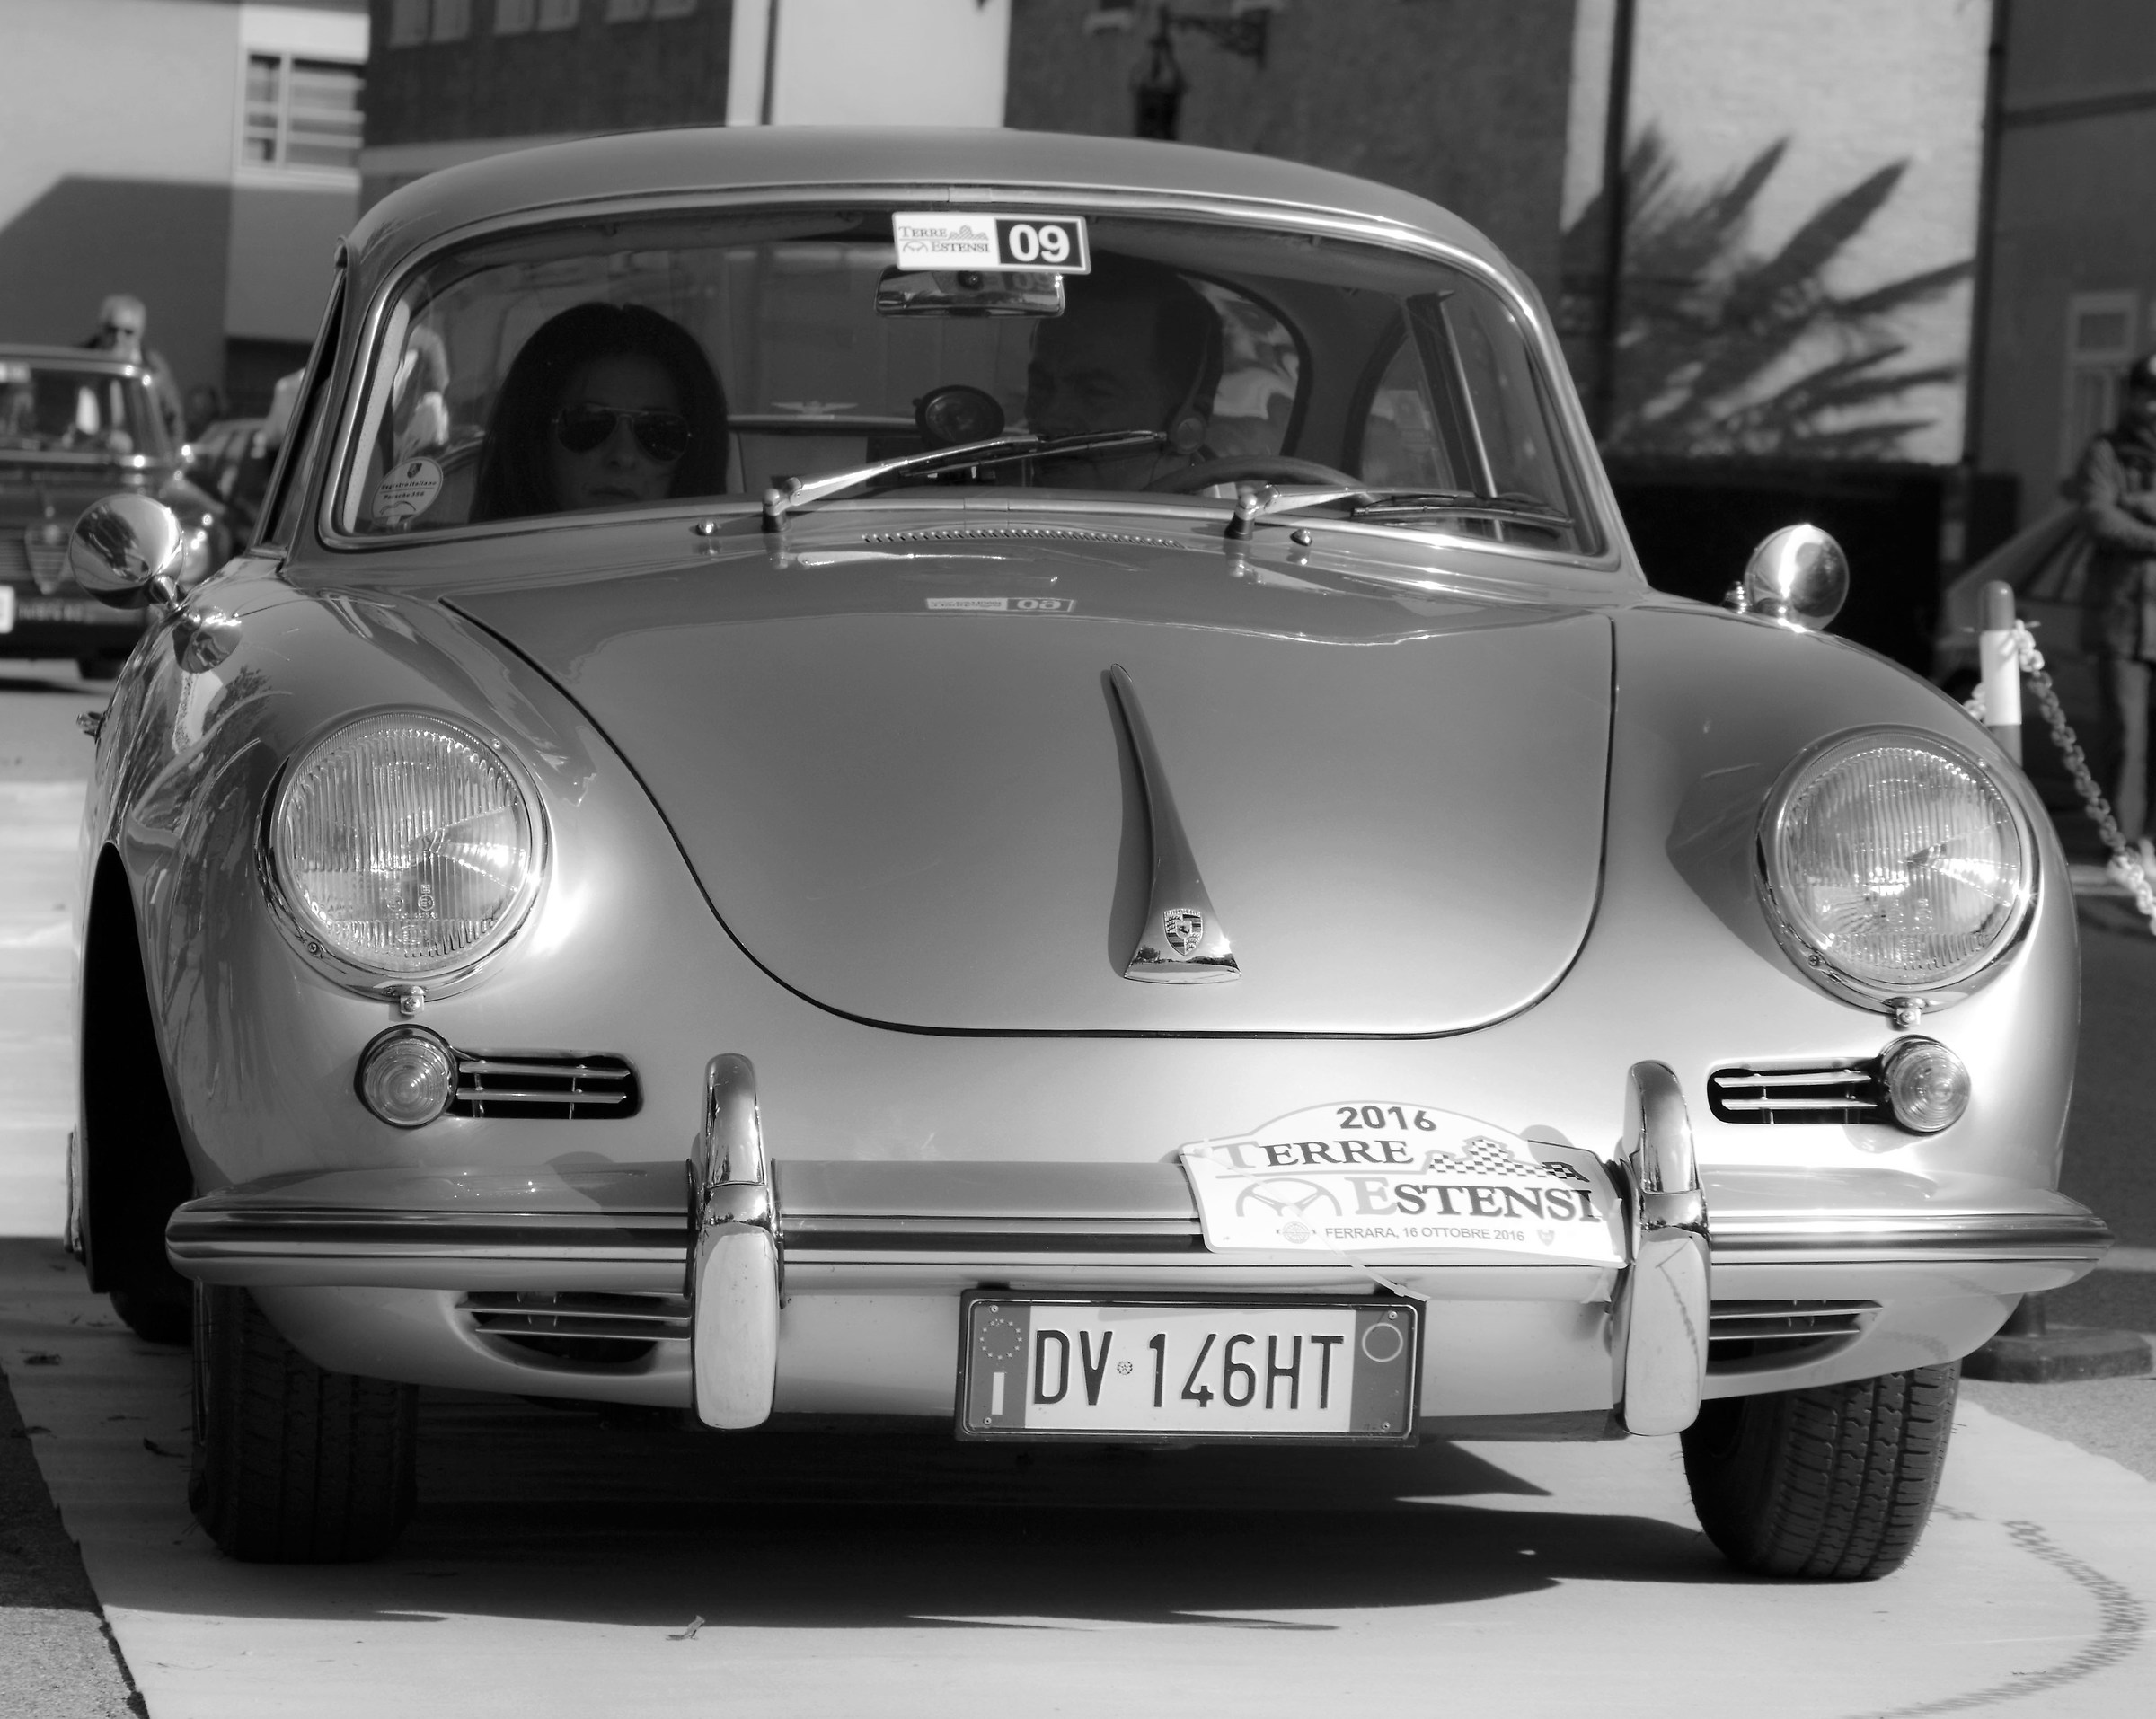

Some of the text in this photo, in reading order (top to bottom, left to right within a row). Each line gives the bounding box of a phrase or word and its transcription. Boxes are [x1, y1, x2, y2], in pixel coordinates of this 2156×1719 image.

[898, 226, 947, 238] TERRE
[1008, 224, 1071, 263] 09
[931, 241, 991, 253] ESTENSI
[1335, 1105, 1437, 1132] 2016
[1212, 1140, 1414, 1169] TERRE
[1344, 1177, 1603, 1223] ESTENSI
[1324, 1226, 1526, 1242] FERRARA, 16 OTTOBRE 2016
[1033, 1329, 1346, 1410] DV 146HT
